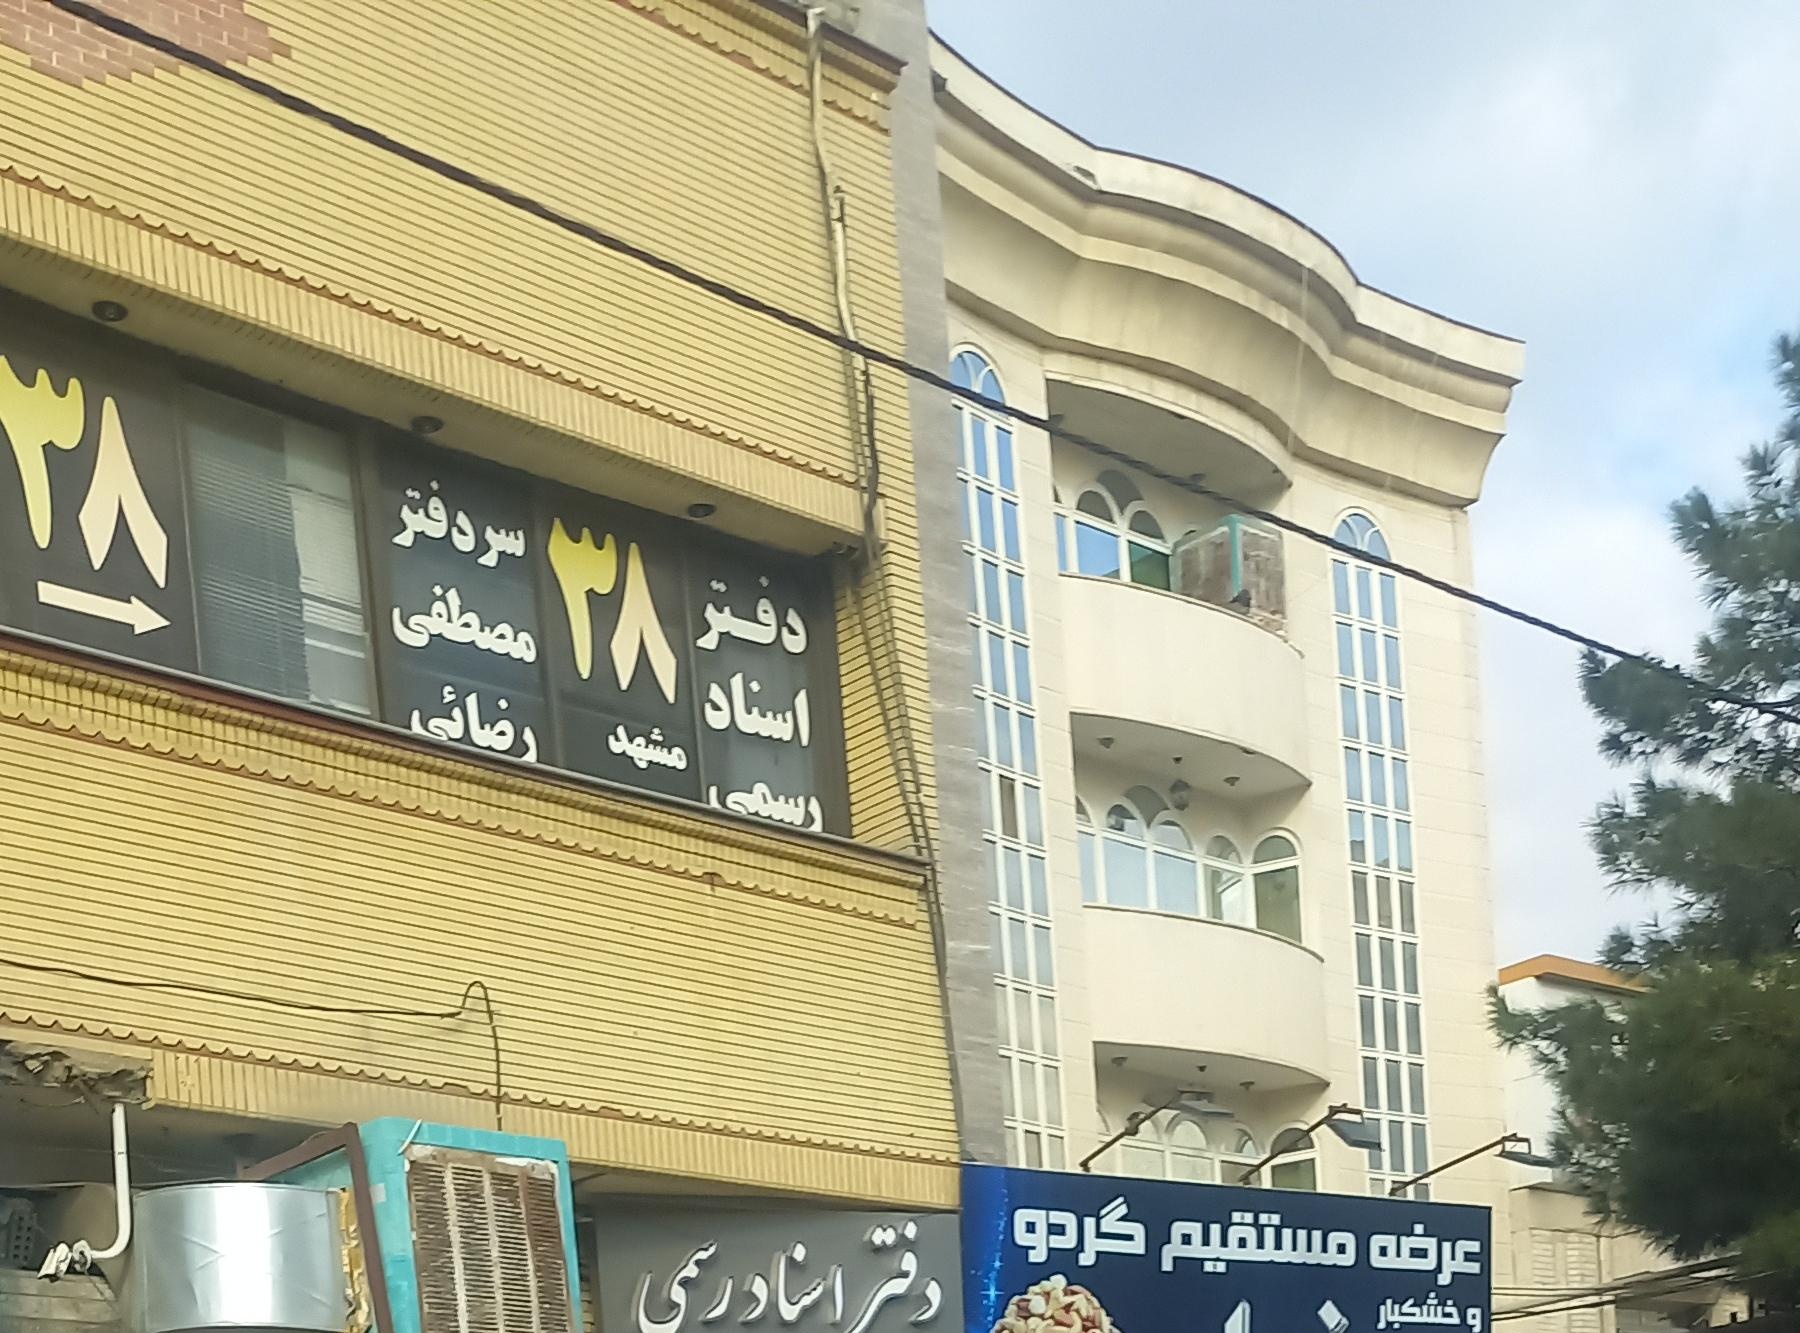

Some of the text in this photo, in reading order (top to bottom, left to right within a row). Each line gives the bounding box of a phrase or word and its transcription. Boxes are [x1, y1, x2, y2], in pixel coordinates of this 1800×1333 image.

[0, 355, 168, 589] ۳۸
[392, 584, 537, 664] مصطفی
[548, 517, 677, 704] ۳۸
[696, 576, 808, 654] دفتر
[607, 724, 688, 771] مشهد
[704, 672, 811, 748] اسناد
[708, 782, 824, 832] رسمی
[1012, 1196, 1483, 1286] عرضه مستقیم گردو
[737, 1240, 846, 1325] اسناد
[1376, 1290, 1462, 1332] خشکبار
